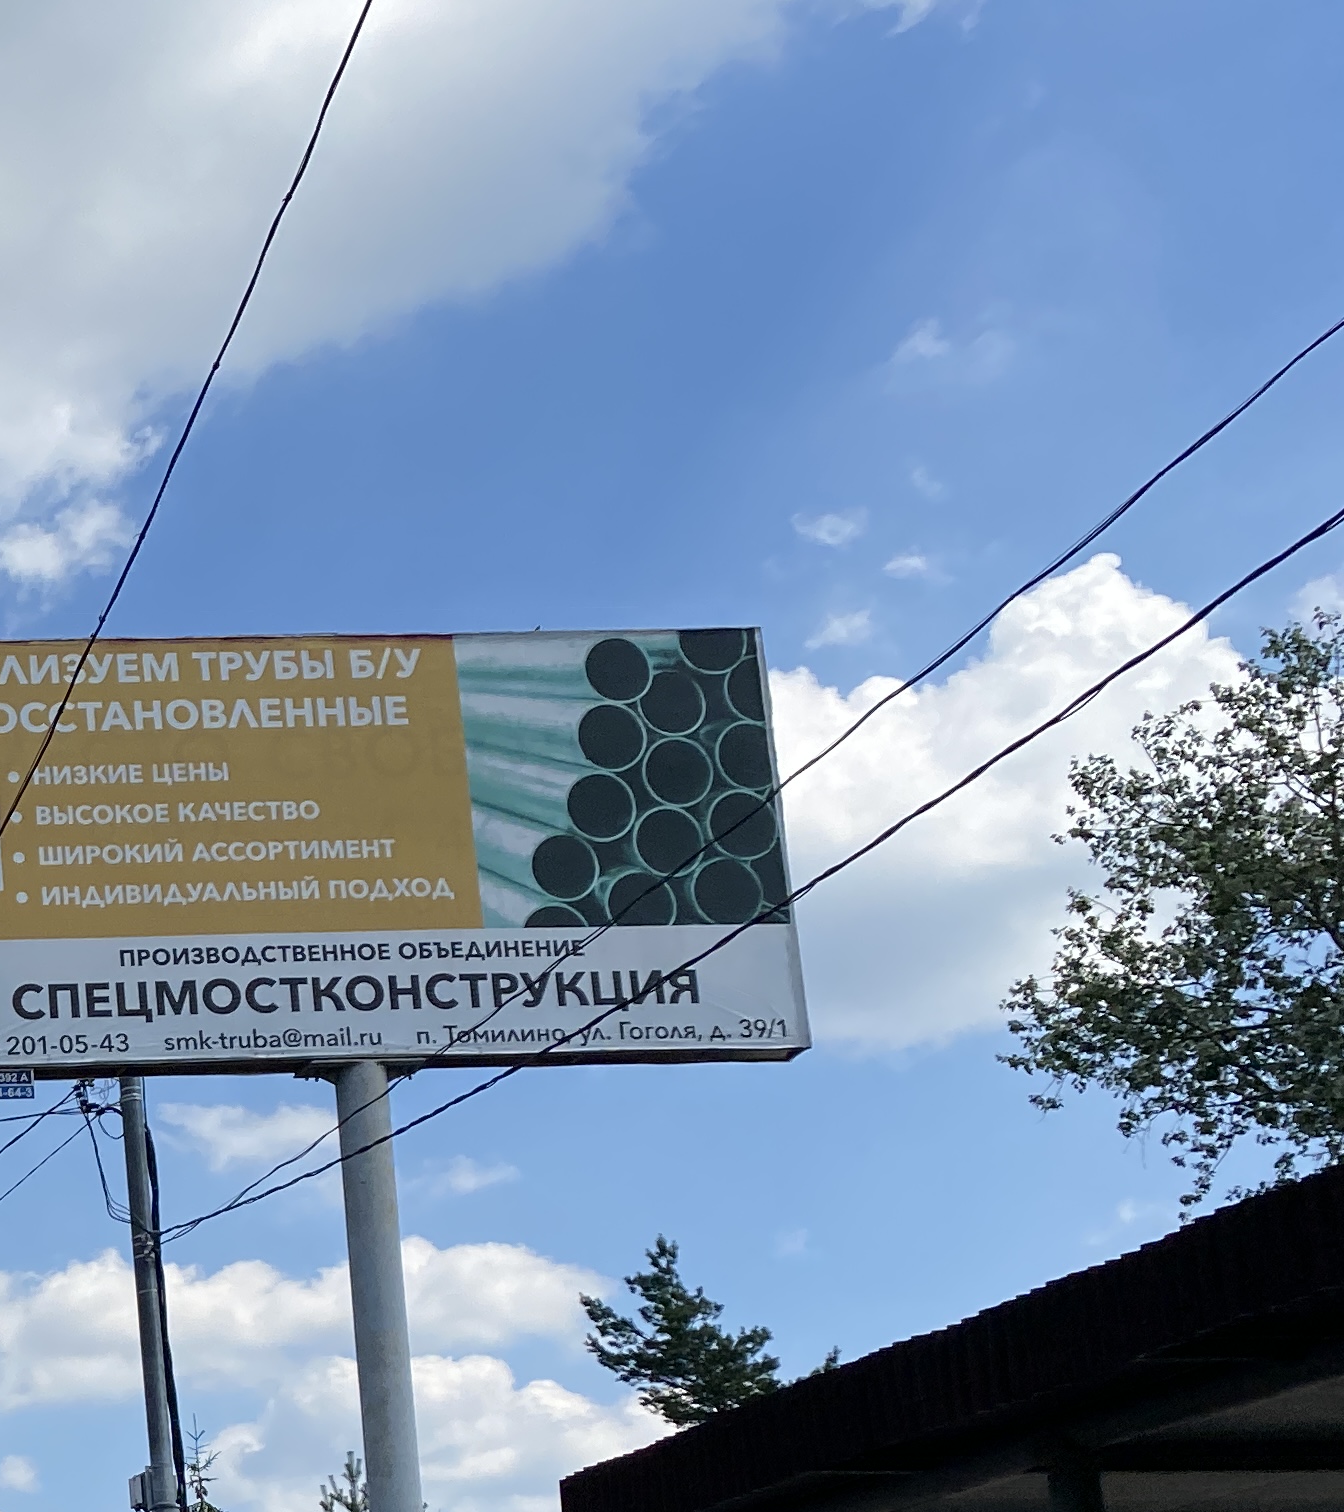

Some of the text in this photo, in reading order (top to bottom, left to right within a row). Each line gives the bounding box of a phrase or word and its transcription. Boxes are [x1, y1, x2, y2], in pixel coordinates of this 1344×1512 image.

[191, 648, 335, 681] ТРУБЫ
[348, 647, 421, 680] Б/У
[33, 761, 230, 785] НИЗКИЕ ЦЕНЫ
[35, 800, 321, 825] ВЫСОКОЕ КАЧЕСТВО
[38, 838, 396, 865] ШИРОКИЙ АССОРТИМЕНТ
[41, 875, 456, 908] ИНДИВИДУАЛЬНЫЙ ПОДХОД
[119, 938, 586, 967] ПРОИЗВОДСТВЕННОЕ ОБЪЕДИНЕНИЕ
[11, 967, 701, 1024] СПЕЦМОСТКОНСТРУКЦИЯ
[7, 1032, 131, 1057] 201-05-43
[164, 1026, 383, 1052] smk-truba@mail.ru
[416, 1030, 437, 1045] п.
[579, 1027, 612, 1046] ул.
[620, 1020, 703, 1043] Гоголя,
[710, 1026, 731, 1041] д.
[739, 1019, 789, 1040] 39/1
